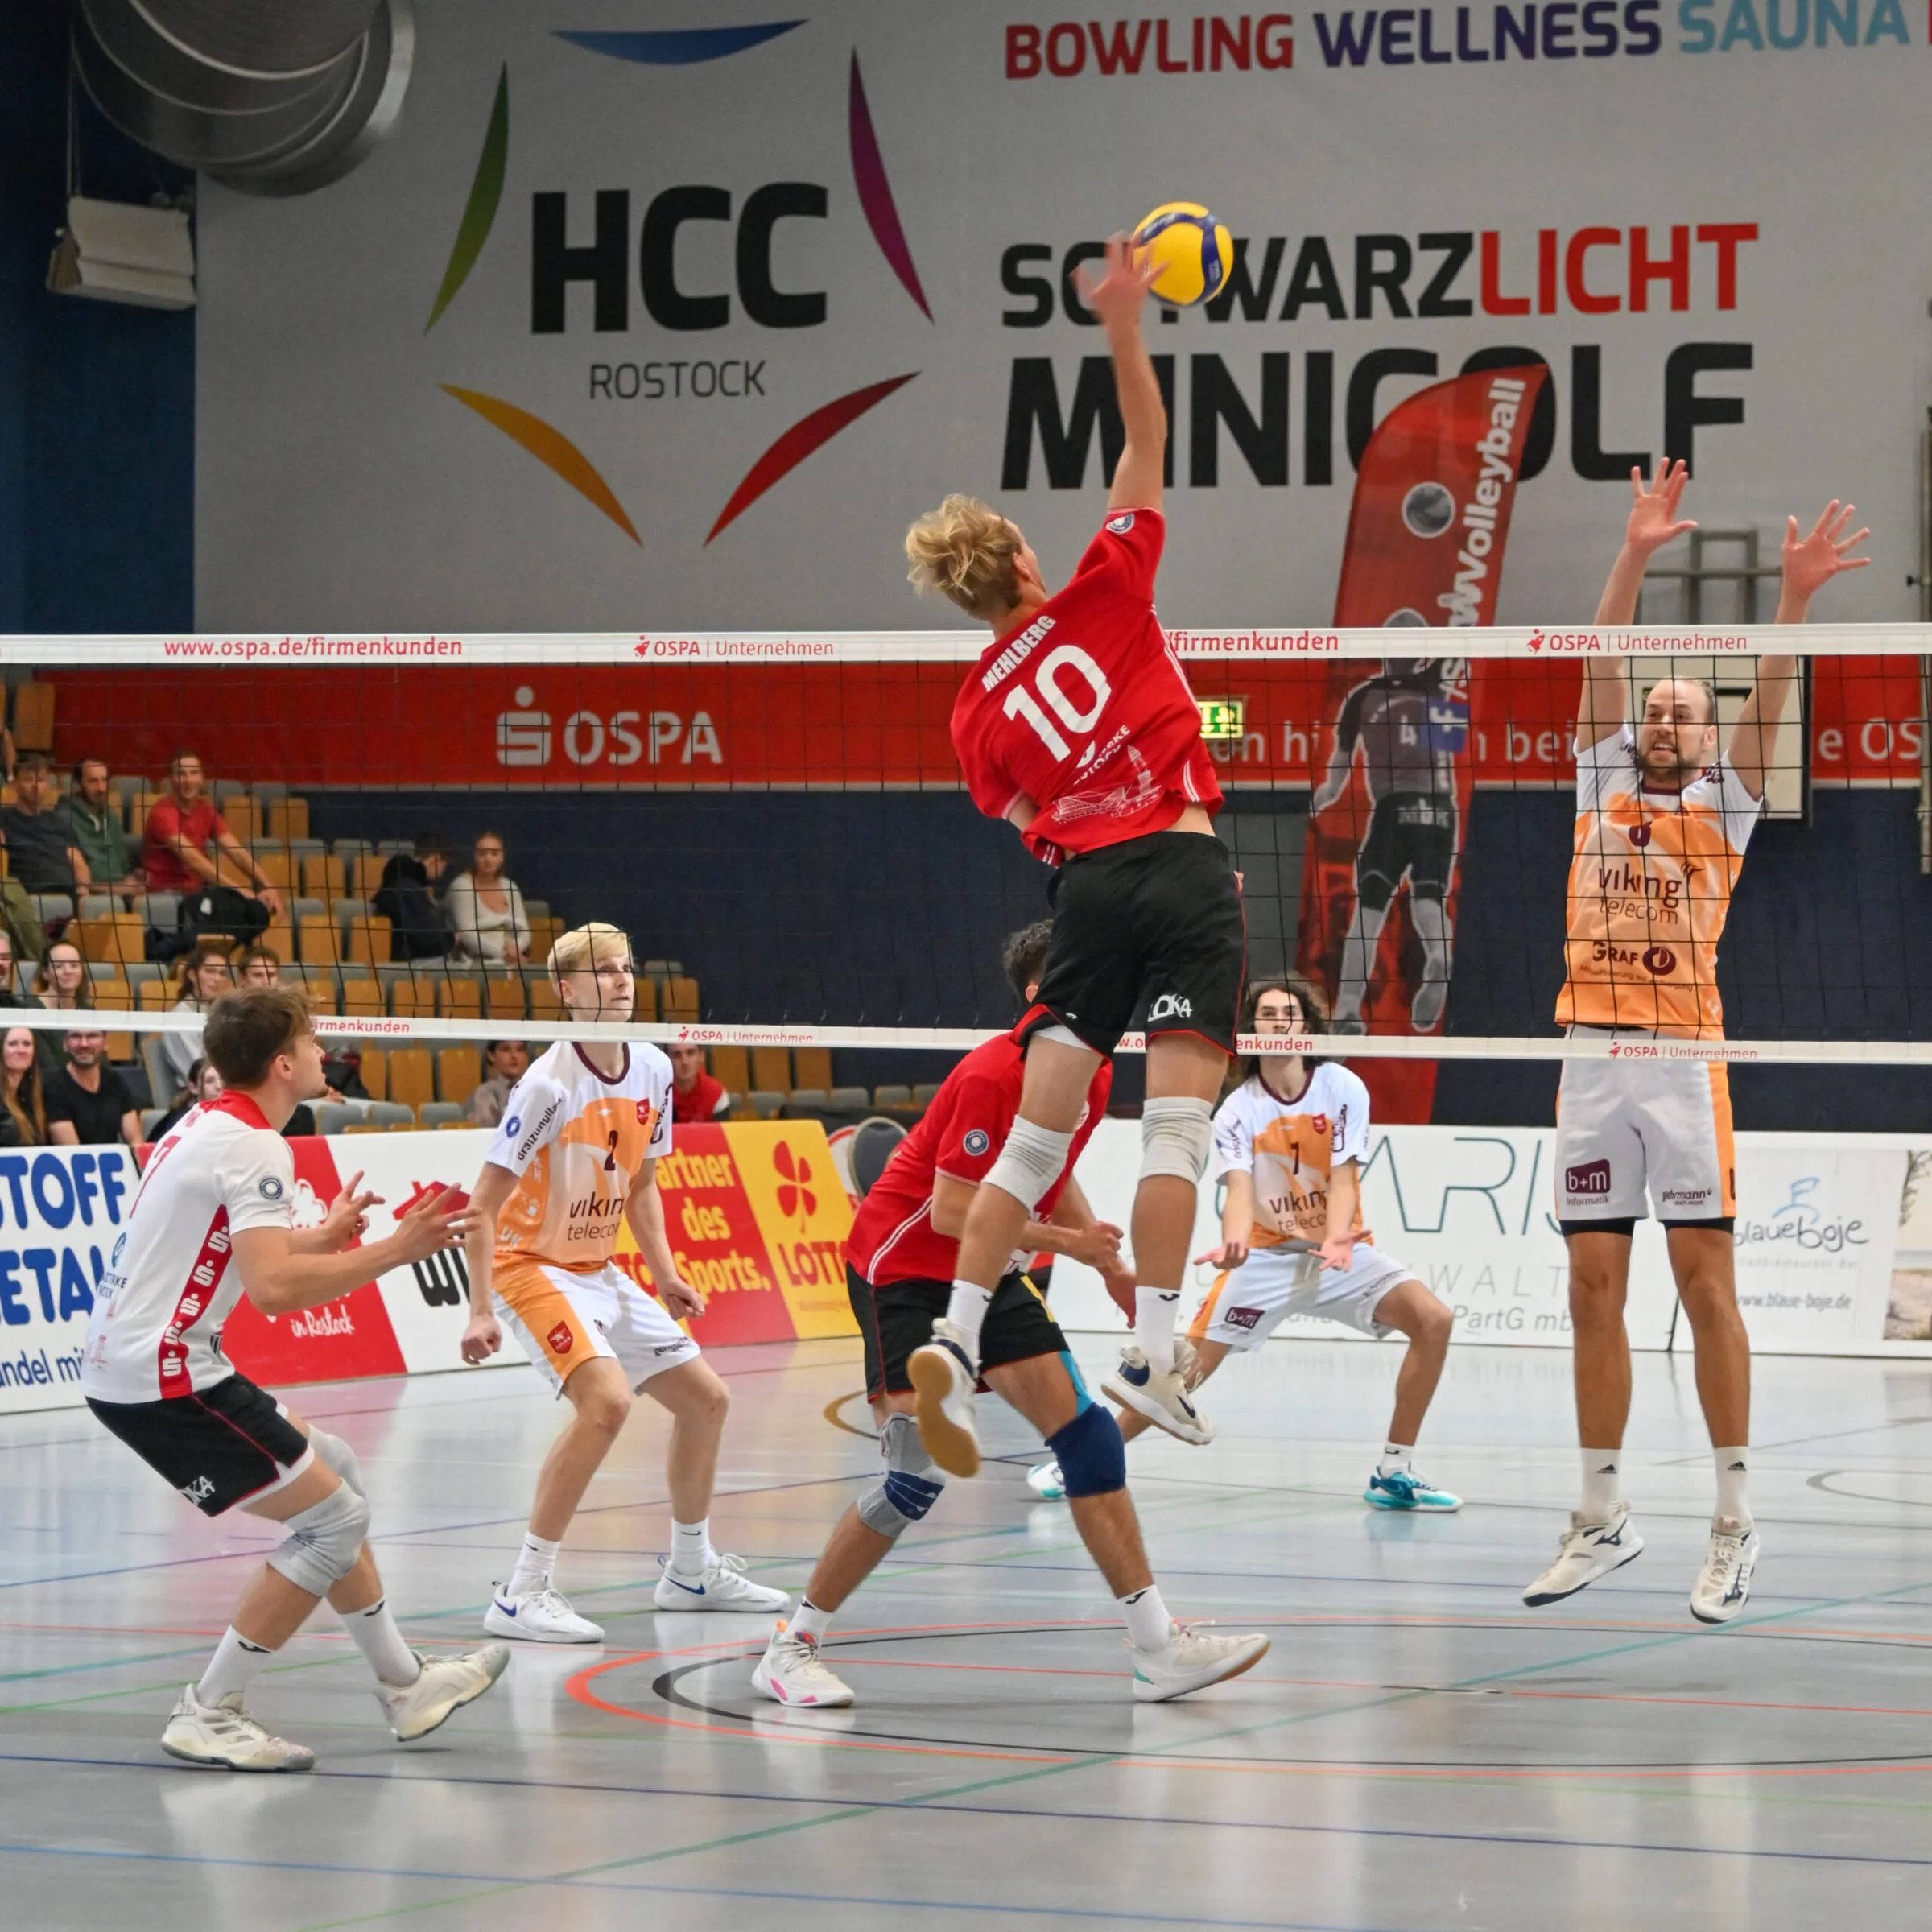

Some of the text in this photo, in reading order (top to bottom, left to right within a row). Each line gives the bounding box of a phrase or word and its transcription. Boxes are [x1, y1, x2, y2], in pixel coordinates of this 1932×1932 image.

[1005, 14, 1294, 79] BOWLING
[1314, 1, 1661, 68] WELLNESS
[1679, 0, 1909, 54] SAUNA
[530, 182, 828, 335] HCC
[1001, 223, 1759, 328] SCWARZLICHT
[589, 360, 766, 400] ROSTOCK
[163, 637, 463, 660] www.ospa.de/firmenkunden
[654, 639, 834, 657] OSPA Unternehmen
[981, 615, 1057, 693] MEHLBERG
[1549, 632, 1748, 652] OSPA Unternehmen
[1002, 644, 1112, 763] 10
[564, 711, 723, 765] OSPA
[1598, 862, 1682, 909] viking
[1600, 898, 1679, 925] telecom
[1592, 939, 1639, 966] GRAF
[315, 1018, 411, 1034] irmenkunden
[691, 1030, 813, 1044] OSPA Unternehmen
[1236, 1036, 1314, 1051] enkunden
[1624, 1046, 1757, 1059] OSPA Unternehmen
[604, 1129, 619, 1171] 2
[656, 1147, 735, 1191] artner
[0, 1152, 126, 1230] TOFF
[1567, 1170, 1608, 1191] b+m
[569, 1191, 625, 1219] vikin
[682, 1196, 731, 1242] des
[1278, 1212, 1327, 1234] teleco
[673, 1249, 771, 1304] Sports.
[778, 1241, 848, 1286] LOTT
[0, 1245, 105, 1326] ETAL
[1453, 1305, 1574, 1332] PartG mb
[56, 1346, 84, 1383] mi
